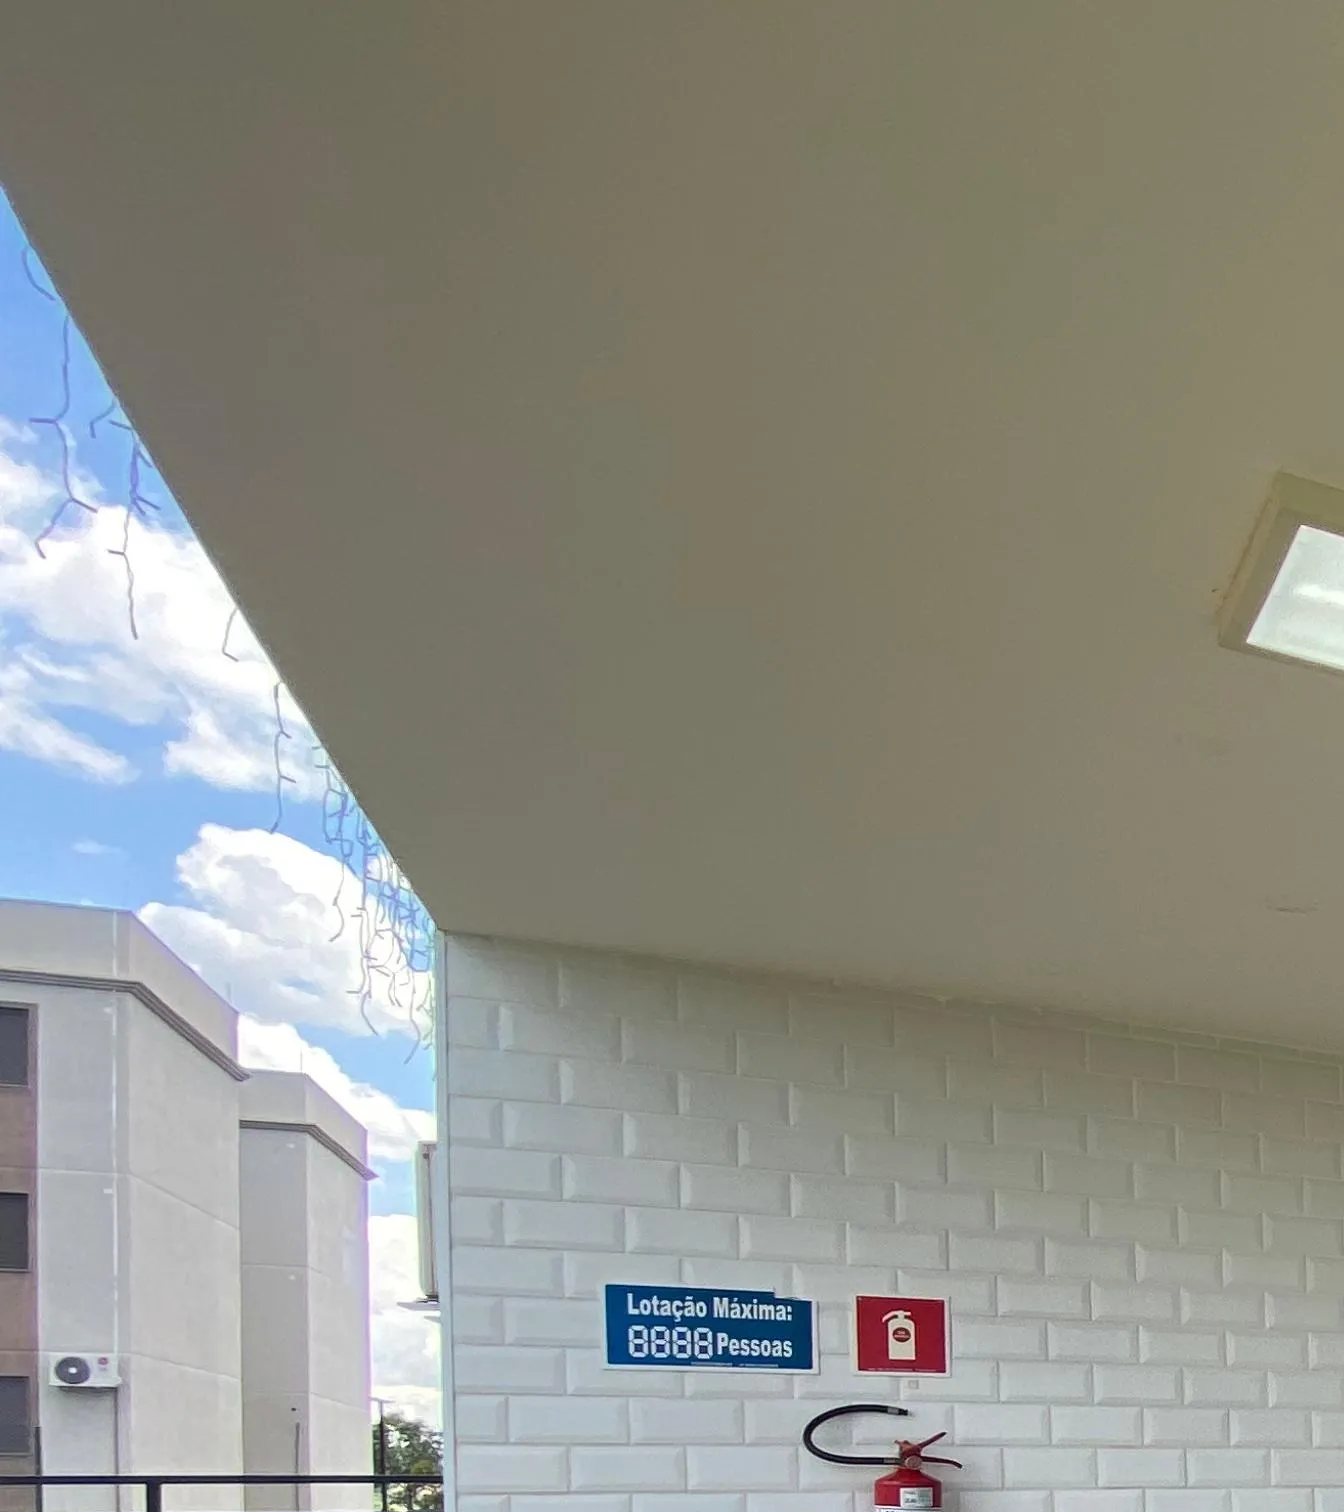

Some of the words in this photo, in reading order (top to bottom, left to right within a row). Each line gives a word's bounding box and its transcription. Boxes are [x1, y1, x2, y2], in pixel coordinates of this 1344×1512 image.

[627, 1293, 707, 1322] Lotação
[713, 1297, 793, 1321] Máxima:
[717, 1332, 793, 1358] Pessoas
